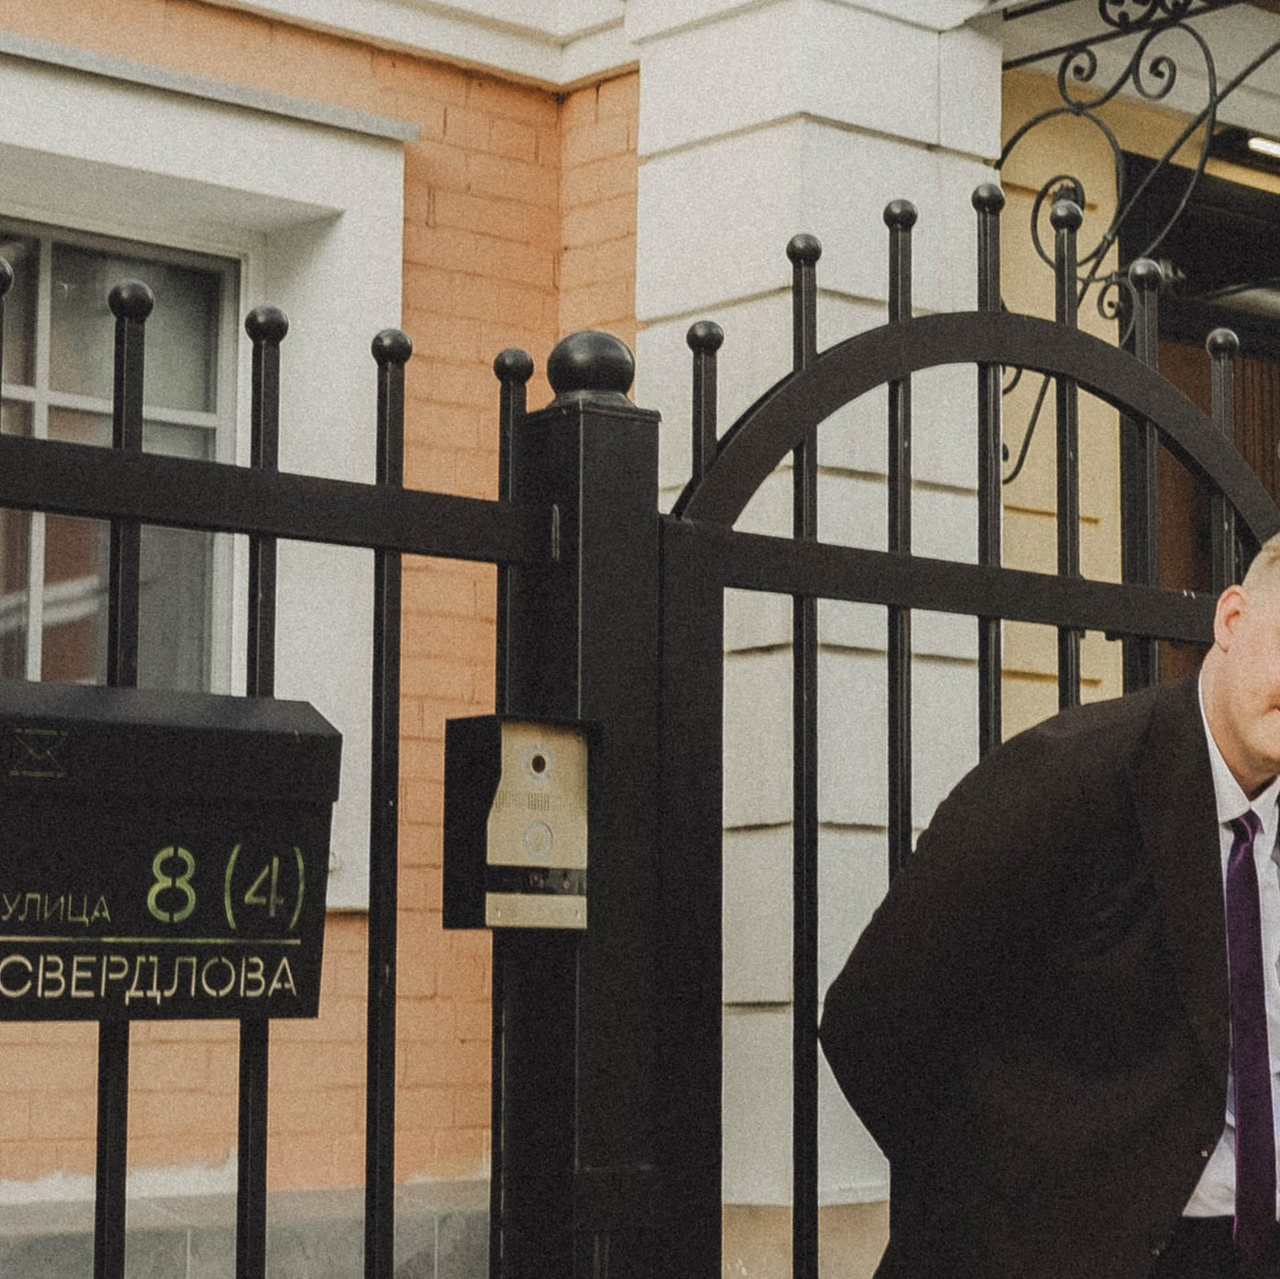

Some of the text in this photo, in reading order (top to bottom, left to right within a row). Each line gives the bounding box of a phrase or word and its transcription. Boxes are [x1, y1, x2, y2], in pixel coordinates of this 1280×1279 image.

[2, 843, 304, 930] УЛИЦА 8 (4)
[0, 955, 297, 1006] СВЕРДЛОВА
